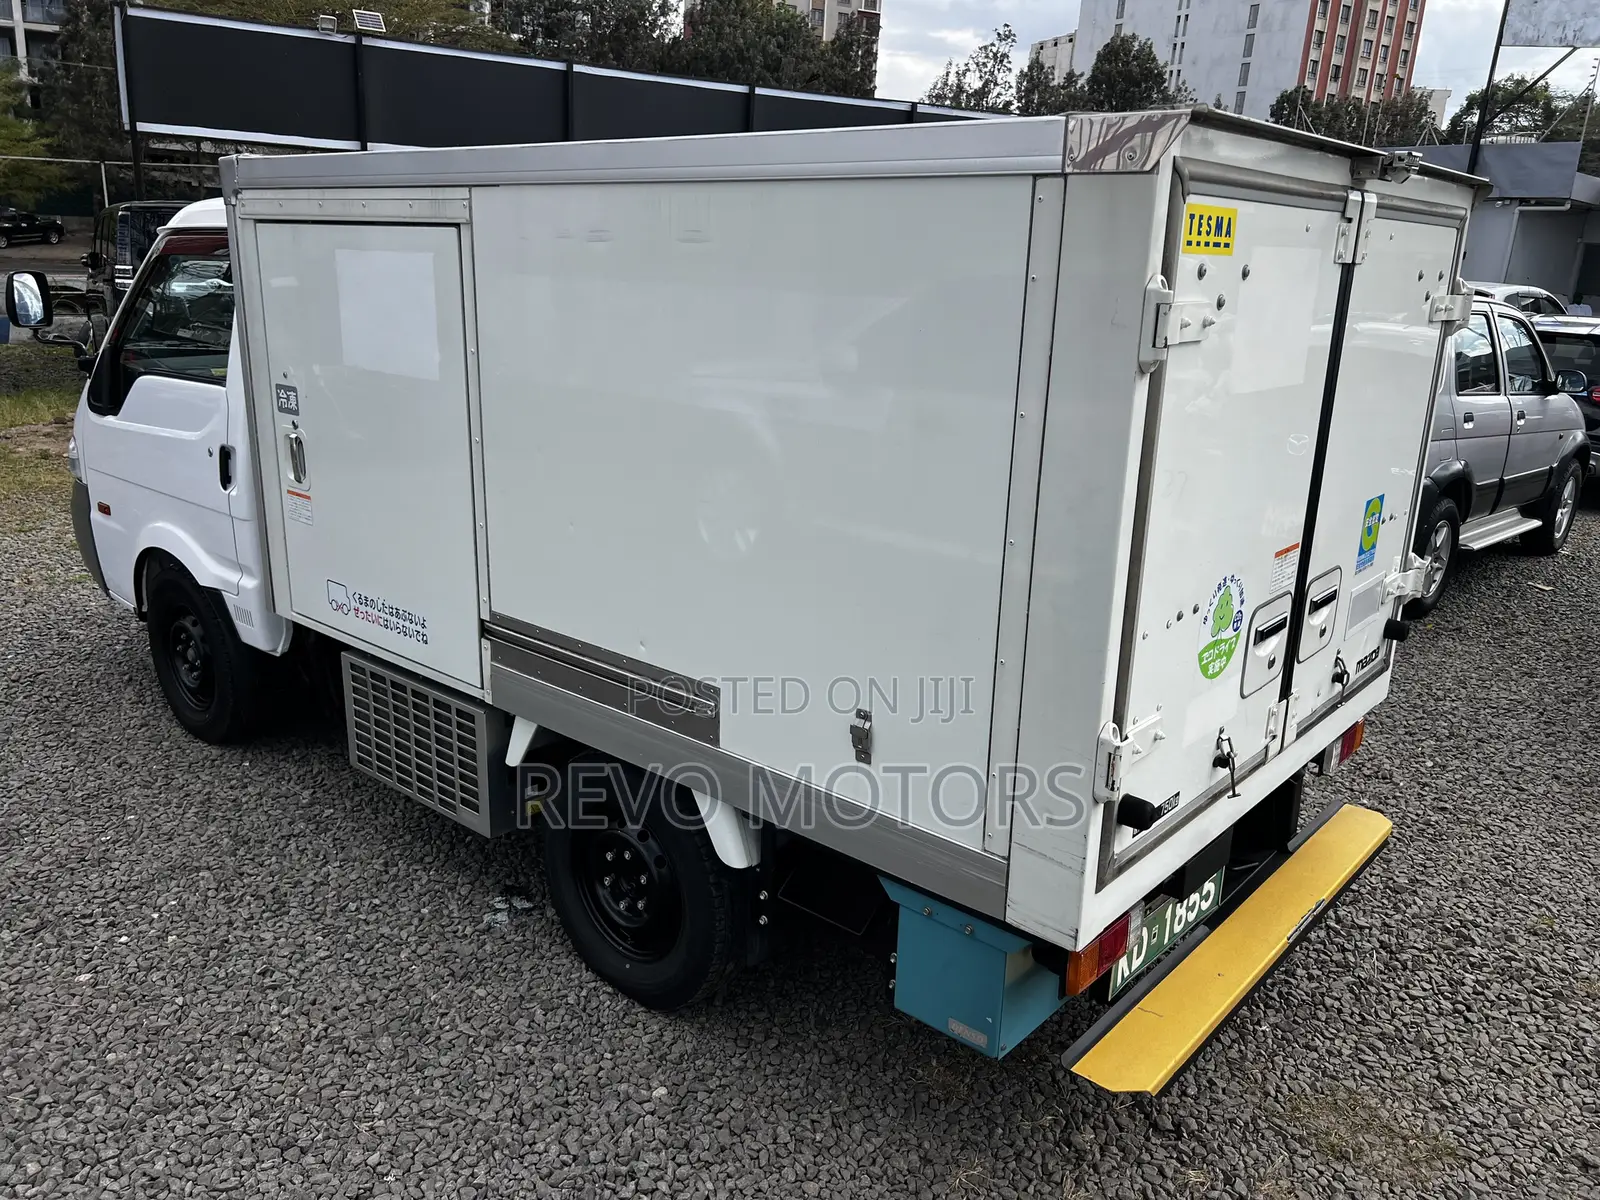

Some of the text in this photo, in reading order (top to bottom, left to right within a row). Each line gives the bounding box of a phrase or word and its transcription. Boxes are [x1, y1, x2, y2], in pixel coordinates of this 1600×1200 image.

[1188, 213, 1232, 238] TESMA
[277, 388, 298, 411] 冷凍
[352, 591, 428, 629] くるまのしたはあぶないよ
[353, 605, 429, 645] ぜったいにはいらないでね
[1355, 645, 1381, 675] mazda
[1163, 873, 1218, 946] 1855
